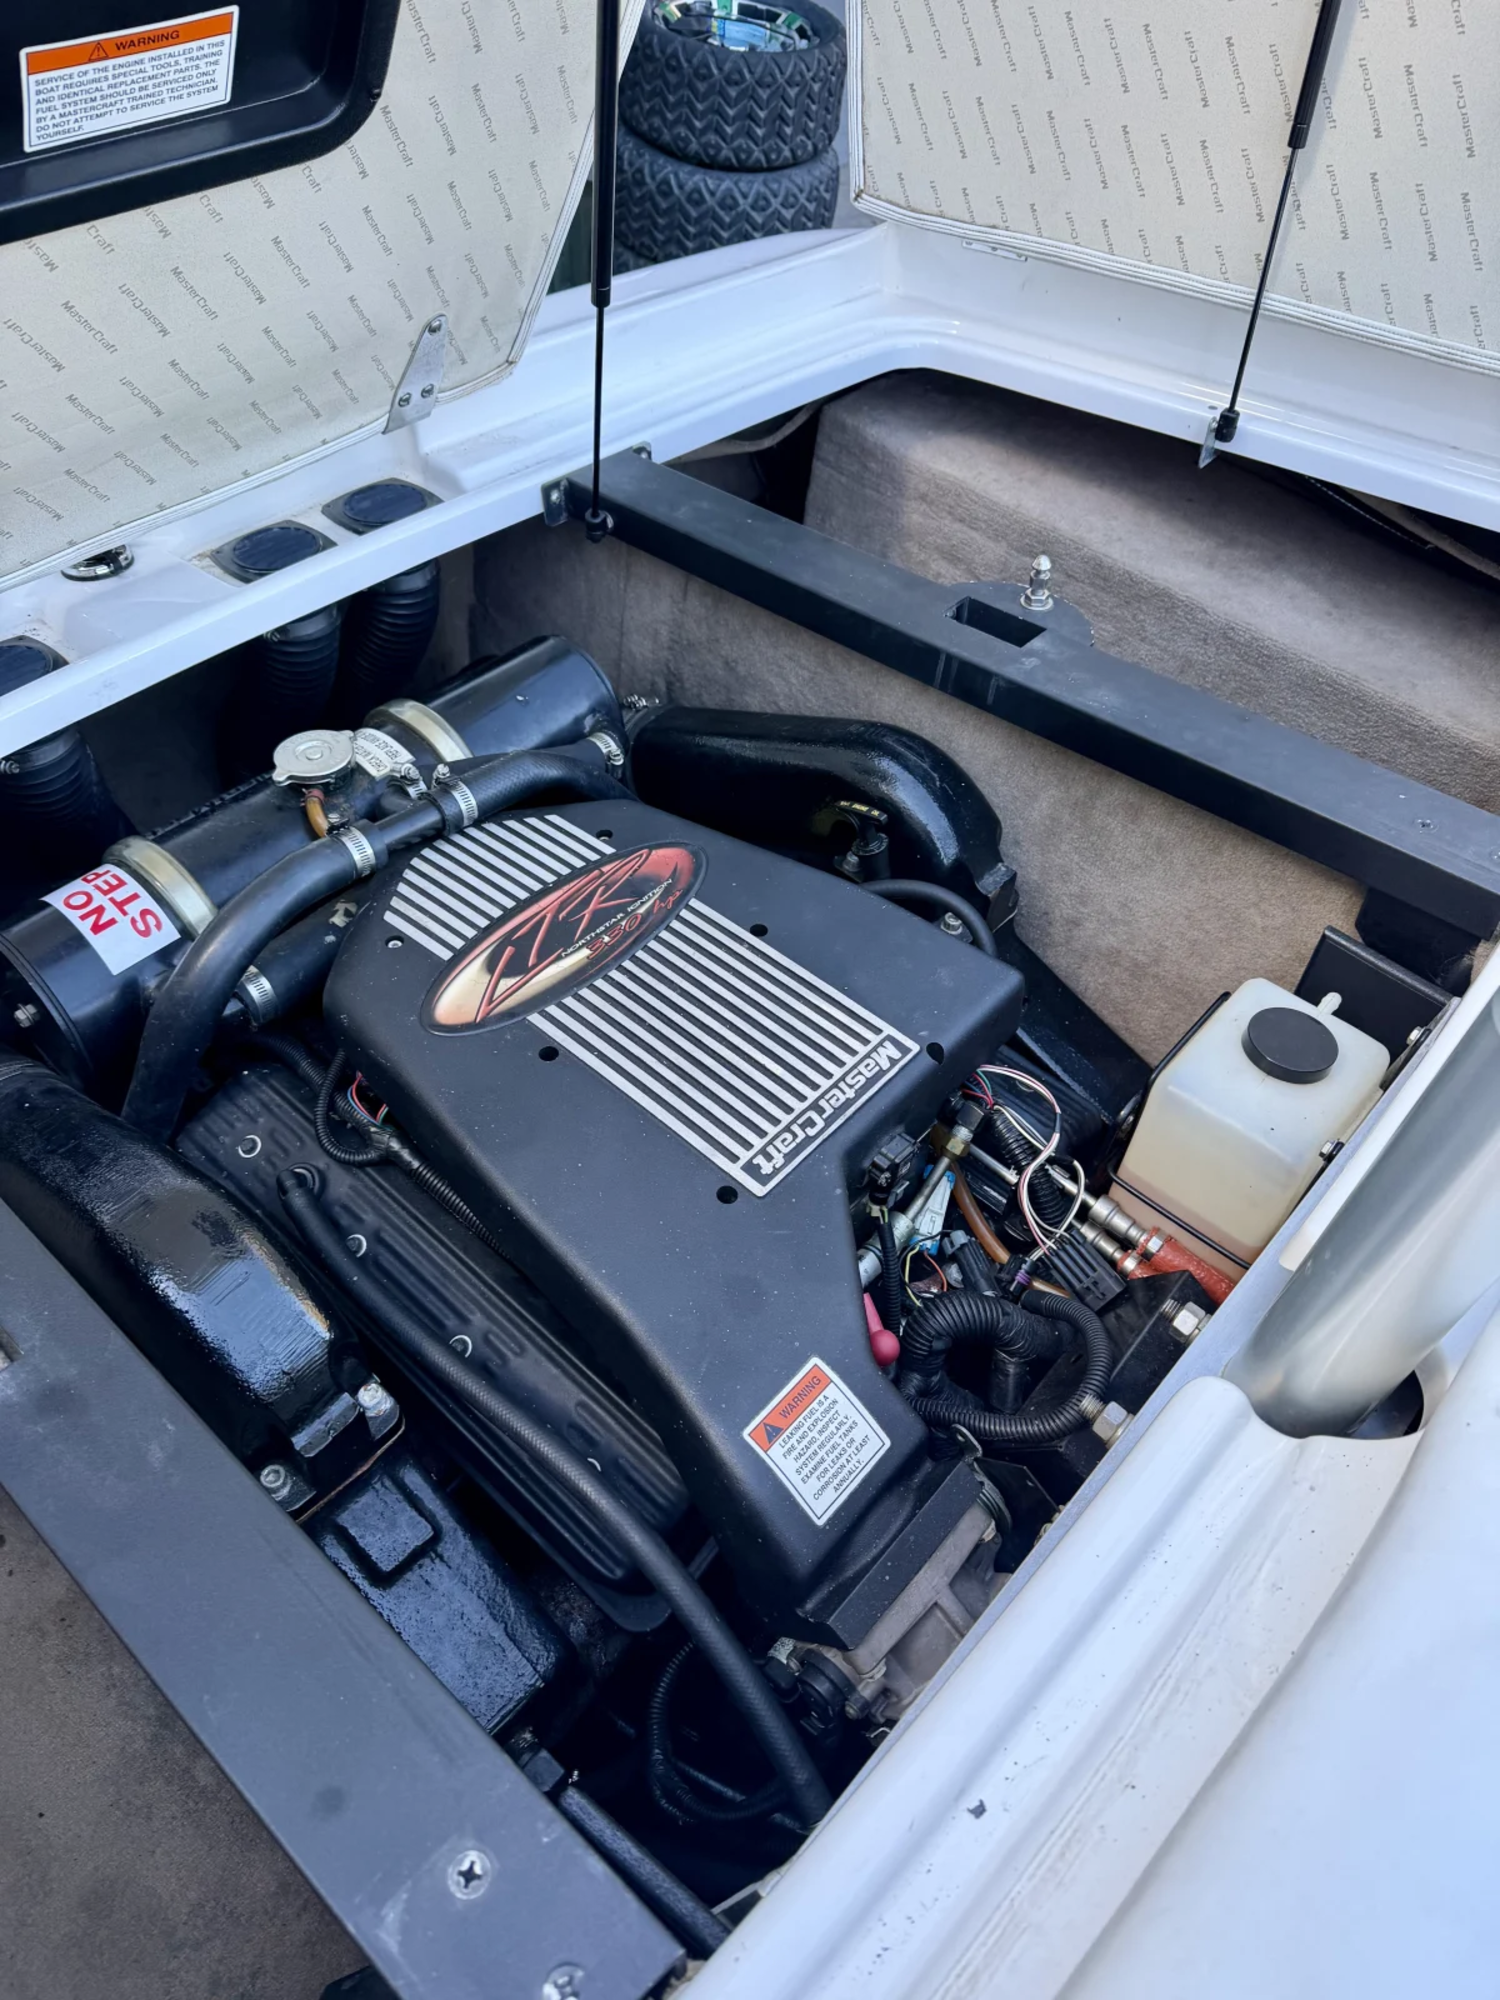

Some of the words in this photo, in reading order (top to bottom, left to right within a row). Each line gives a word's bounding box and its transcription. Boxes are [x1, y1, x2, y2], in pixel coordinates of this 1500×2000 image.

[35, 73, 75, 87] SERVICE
[77, 70, 90, 78] OF
[92, 65, 110, 75] THE
[112, 56, 147, 71] ENGINE
[148, 47, 194, 63] INSTALLED
[196, 44, 205, 52] IN
[207, 39, 225, 50] THIS
[115, 30, 180, 51] WARNING
[1027, 5, 1054, 80] MasterCraft
[1064, 11, 1091, 86] MasterCraft
[1103, 18, 1130, 94] MasterCraft
[1142, 23, 1168, 100] MasterCraft
[36, 85, 60, 96] BOAT
[63, 75, 109, 90] REQUIRES
[112, 67, 148, 81] SPECIAL
[184, 50, 223, 64] TRAINING
[36, 96, 55, 105] AND
[57, 86, 105, 100] IDENTICAL
[107, 71, 172, 90] REPLACEMENT
[204, 59, 221, 69] THE
[36, 105, 59, 114] FUEL
[61, 96, 97, 109] SYSTEM
[100, 86, 136, 101] SHOULD
[138, 83, 150, 92] BE
[152, 74, 194, 90] SERVICED
[195, 69, 217, 79] ONLY
[557, 65, 579, 124] MasterCraft
[1184, 31, 1210, 108] MasterCraft
[1225, 36, 1251, 114] MasterCraft
[36, 115, 48, 124] BY
[59, 99, 125, 118] MASTERCRAFT
[126, 90, 163, 103] TRAINED
[36, 124, 50, 133] DO
[52, 119, 71, 129] NOT
[73, 109, 114, 124] ATTEMPT
[115, 107, 128, 115] TO
[130, 98, 166, 112] SERVICE
[168, 92, 185, 102] THE
[186, 85, 219, 99] SYSTEM
[471, 83, 497, 143] MasterCraft
[515, 73, 540, 135] MasterCraft
[877, 77, 902, 145] MasterCraft
[908, 83, 934, 151] MasterCraft
[942, 90, 968, 159] MasterCraft
[1358, 57, 1383, 139] MasterCraft
[1404, 64, 1428, 147] MasterCraft
[1452, 74, 1476, 158] MasterCraft
[380, 104, 414, 168] MasterCraft
[428, 95, 457, 156] MasterCraft
[975, 96, 1001, 166] MasterCraft
[1011, 104, 1037, 174] MasterCraft
[1046, 110, 1071, 181] MasterCraft
[1084, 118, 1109, 190] MasterCraft
[1121, 124, 1146, 198] MasterCraft
[1160, 133, 1186, 206] MasterCraft
[1200, 139, 1224, 213] MasterCraft
[448, 181, 472, 231] MasterCraft
[488, 169, 514, 223] MasterCraft
[529, 160, 550, 212] MasterCraft
[1241, 148, 1265, 223] MasterCraft
[1326, 164, 1350, 241] MasterCraft
[1369, 172, 1393, 250] MasterCraft
[362, 205, 393, 257] MasterCraft
[406, 193, 435, 245] MasterCraft
[1415, 183, 1438, 262] MasterCraft
[1461, 192, 1483, 272] MasterCraft
[270, 235, 311, 289] MasterCraft
[319, 220, 354, 274] MasterCraft
[170, 266, 218, 320] MasterCraft
[223, 251, 267, 305] MasterCraft
[387, 279, 414, 322] MasterCraft
[426, 265, 450, 309] MasterCraft
[464, 253, 490, 299] MasterCraft
[60, 300, 118, 354] MasterCraft
[118, 283, 171, 338] MasterCraft
[306, 310, 339, 353] MasterCraft
[348, 294, 377, 338] MasterCraft
[4, 318, 65, 372] MasterCraft
[217, 343, 255, 384] MasterCraft
[261, 326, 297, 368] MasterCraft
[119, 376, 164, 418] MasterCraft
[168, 359, 210, 400] MasterCraft
[292, 384, 323, 420] MasterCraft
[331, 369, 360, 405] MasterCraft
[11, 412, 66, 453] MasterCraft
[65, 393, 115, 435] MasterCraft
[206, 417, 242, 452] MasterCraft
[250, 400, 282, 435] MasterCraft
[113, 450, 157, 486] MasterCraft
[160, 433, 200, 468] MasterCraft
[13, 487, 64, 522] MasterCraft
[64, 468, 111, 503] MasterCraft
[63, 890, 119, 936] NO
[80, 869, 163, 939] STEP
[561, 913, 625, 958] NORTHSTAR
[627, 878, 673, 912] IGNITION
[586, 913, 642, 960] 330
[752, 1040, 902, 1175] MasterCraft
[779, 1376, 821, 1419] WARNING
[779, 1420, 804, 1449] LEAKING
[802, 1406, 819, 1423] FUEL
[816, 1400, 824, 1408] IS
[816, 1410, 840, 1437] INSPECT
[782, 1444, 797, 1459] FIRE
[796, 1431, 809, 1445] AND
[807, 1398, 838, 1432] EXPLOSION
[801, 1455, 827, 1484] EXAMINE
[825, 1441, 841, 1457] FUEL
[839, 1420, 858, 1441] TANKS
[795, 1449, 819, 1475] SYSTEM
[813, 1462, 846, 1500] CORROSION
[845, 1454, 854, 1465] AT
[852, 1434, 870, 1456] LEAST
[816, 1467, 830, 1482] FOR
[827, 1447, 847, 1469] LEAKS
[846, 1437, 856, 1449] OR
[833, 1459, 864, 1493] ANNUALLY.
